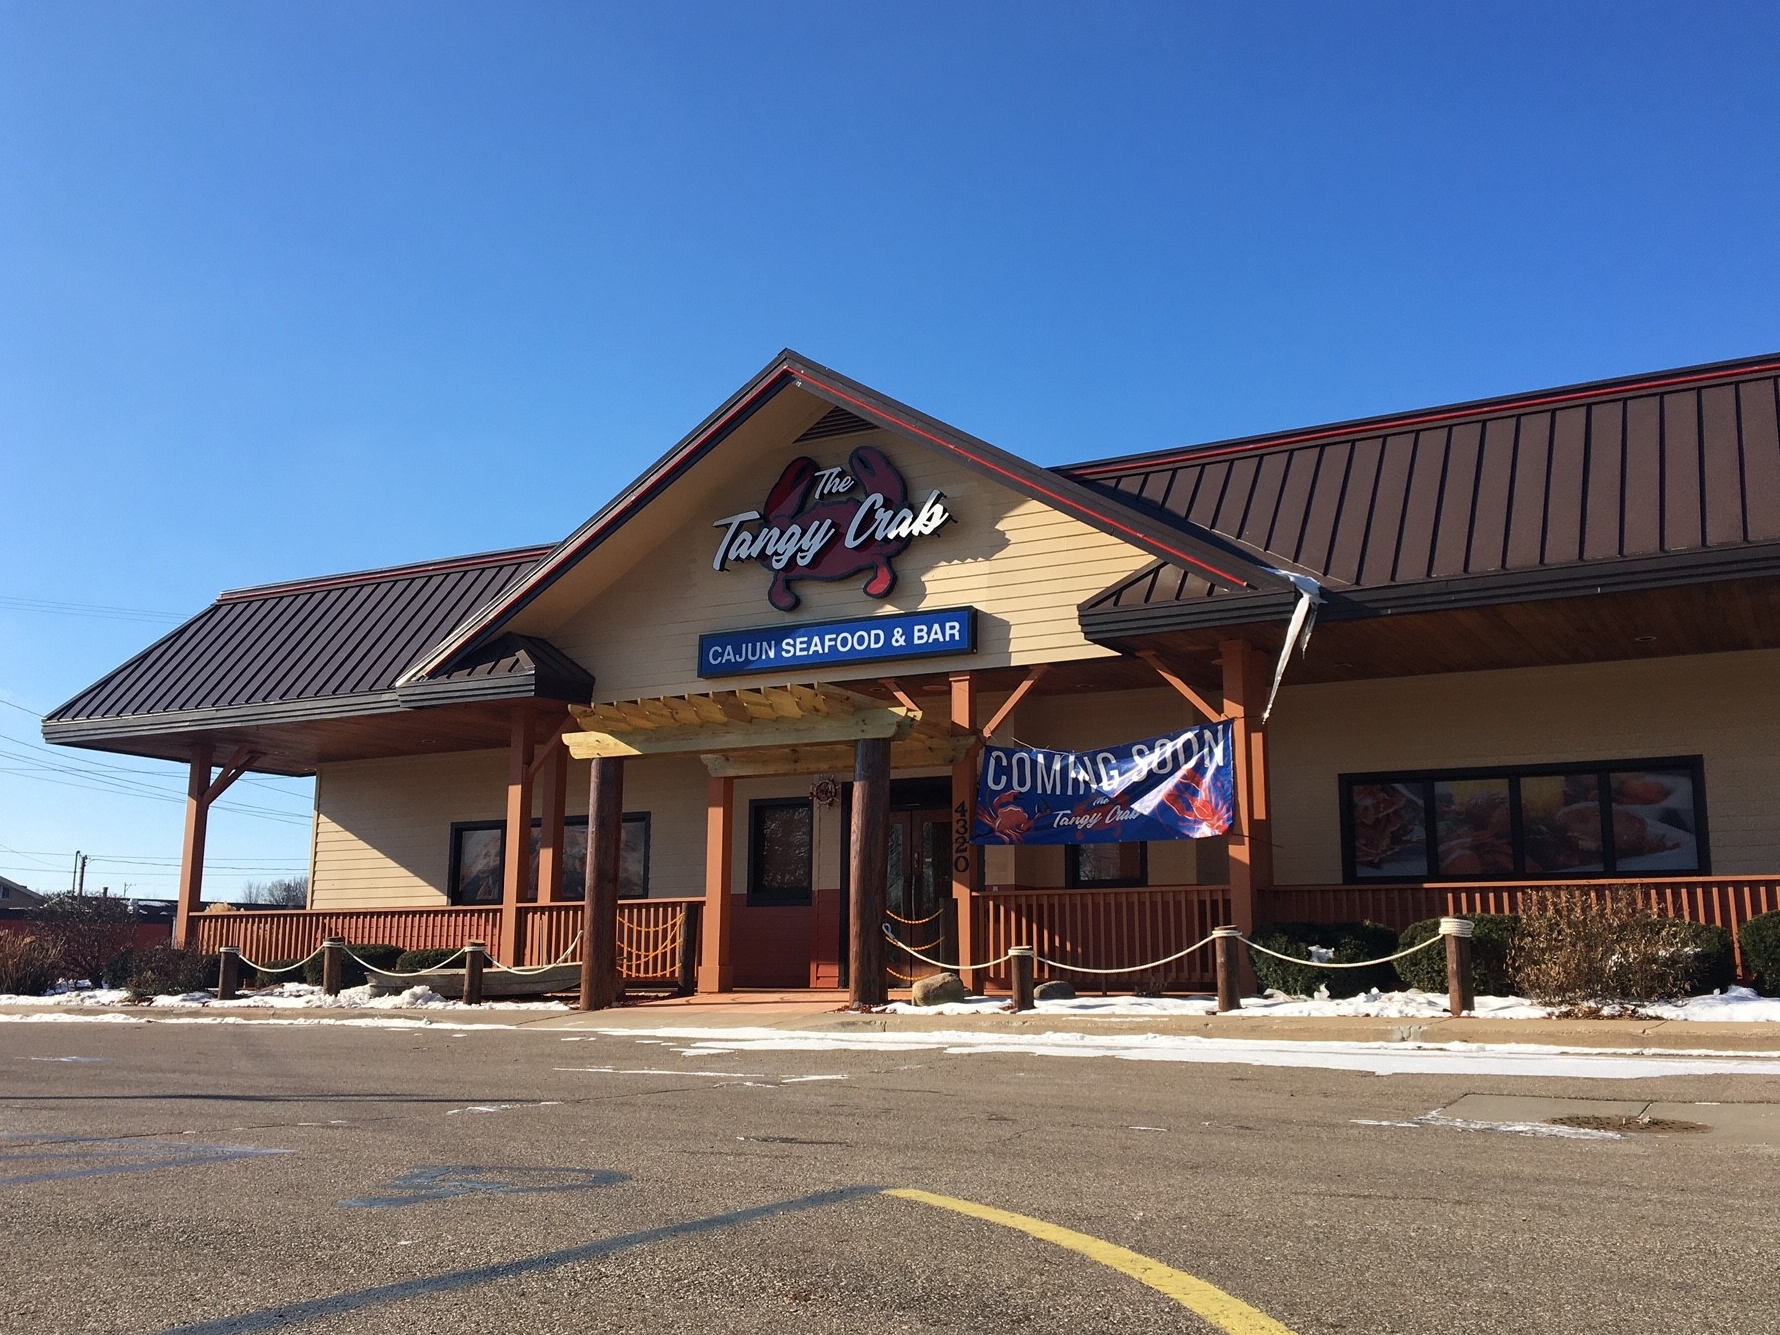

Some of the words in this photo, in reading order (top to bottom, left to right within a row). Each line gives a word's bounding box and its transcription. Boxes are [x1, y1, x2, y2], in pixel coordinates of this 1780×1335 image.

[814, 467, 854, 499] The
[712, 510, 835, 572] Tangy
[845, 489, 949, 549] Crab
[708, 640, 776, 665] CAJUN
[781, 629, 885, 658] SEAFOOD
[891, 627, 907, 647] &
[913, 621, 960, 645] BAR
[987, 750, 1119, 796] COMING
[1131, 724, 1225, 783] SOON
[953, 800, 970, 873] 4320
[1052, 809, 1102, 829] Tangy
[1104, 805, 1141, 822] Crab
